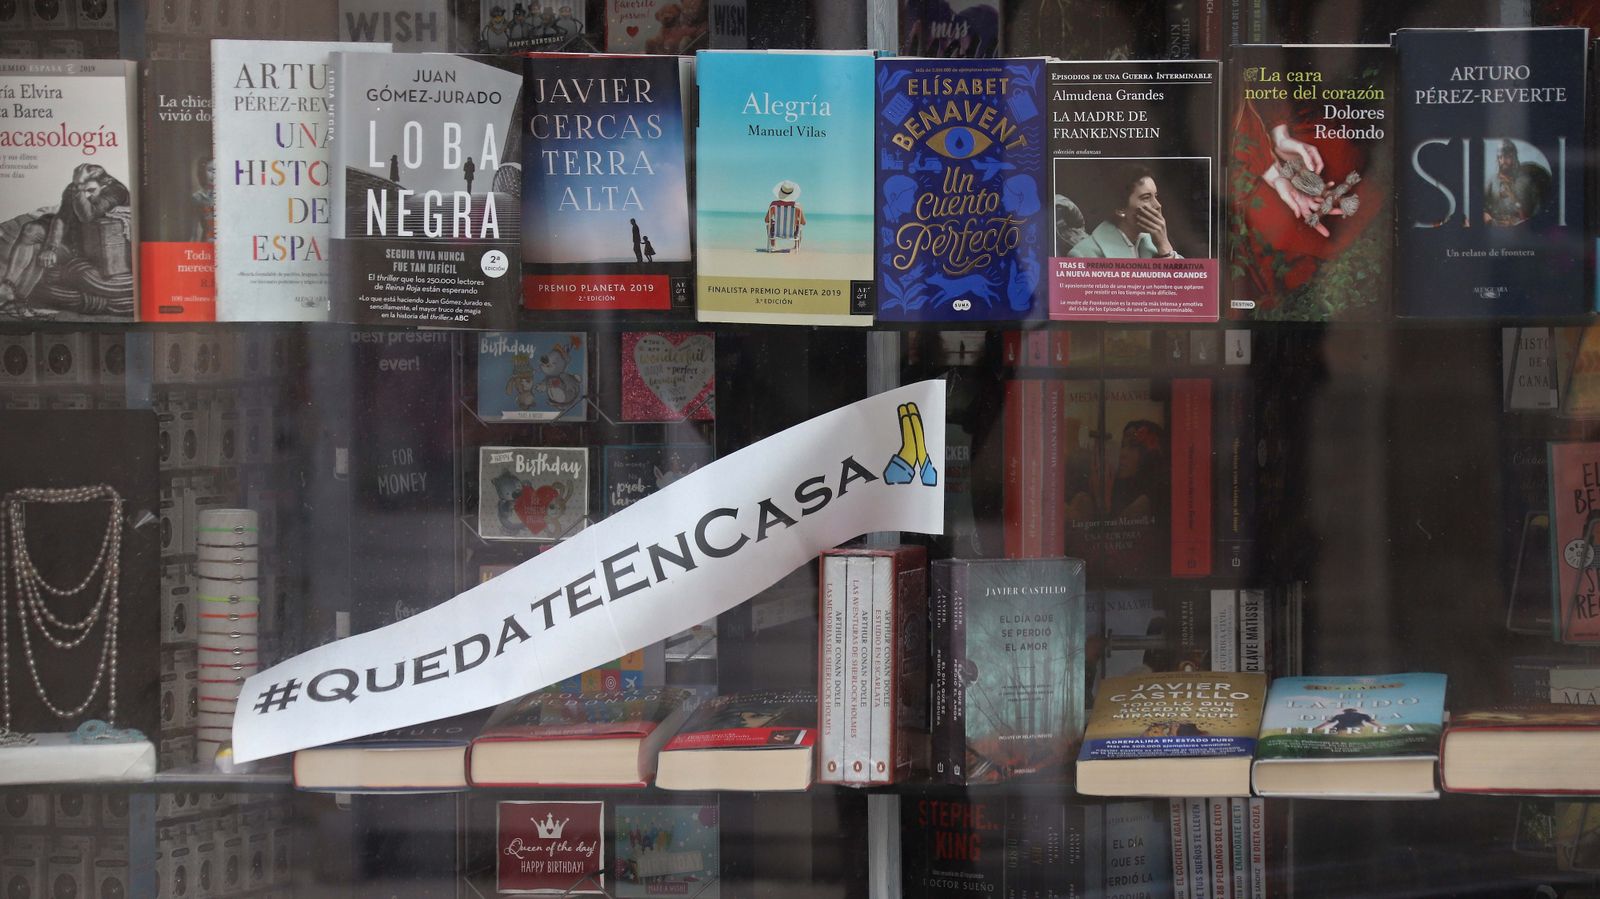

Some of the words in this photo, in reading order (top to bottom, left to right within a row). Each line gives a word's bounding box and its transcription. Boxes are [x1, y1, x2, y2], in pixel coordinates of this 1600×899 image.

[346, 12, 436, 42] WISH
[714, 5, 745, 36] WISH
[234, 63, 329, 89] ARTU
[413, 70, 456, 82] JUAN
[1260, 67, 1281, 82] La
[1287, 71, 1323, 82] cara
[1450, 65, 1531, 81] ARTURO
[20, 83, 63, 99] Elvira
[535, 78, 654, 103] JAVIER
[908, 75, 1009, 95] ELÍSABET
[1245, 88, 1287, 100] norte
[1294, 85, 1317, 100] del
[1322, 85, 1385, 100] corazón
[160, 95, 177, 107] La
[234, 92, 329, 112] PÉREZ-REV
[367, 85, 502, 104] GÓMEZ-JURADO
[1053, 90, 1112, 101] Almudena
[1116, 89, 1164, 100] Grandes
[1415, 87, 1567, 105] PÉREZ-REVERTE
[13, 104, 53, 118] Barea
[159, 109, 191, 121] vivió
[742, 92, 832, 122] Alegría
[1323, 105, 1385, 119] Dolores
[1053, 111, 1070, 122] LA
[1074, 111, 1124, 122] MADRE
[1128, 111, 1147, 121] DE
[530, 114, 662, 139] CERCAS
[749, 125, 793, 136] Manuel
[797, 126, 826, 137] Vilas
[892, 100, 1027, 151] BENAVENT
[1053, 128, 1160, 138] FRANKENSTEIN
[1314, 125, 1385, 139] Redondo
[0, 121, 118, 155] acasología
[370, 121, 499, 170] LOBA
[542, 150, 655, 176] TERRA
[235, 160, 329, 186] HISTO
[943, 166, 974, 194] Un
[1412, 137, 1568, 228] SIDI
[558, 186, 645, 211] ALTA
[916, 189, 999, 220] Cuento
[289, 198, 329, 224] DE
[367, 189, 500, 239] NEGRA
[253, 236, 326, 261] ESPA
[894, 215, 1027, 276] Perfecto
[1447, 249, 1460, 257] Un
[1462, 248, 1486, 257] relato
[1489, 249, 1499, 257] de
[1501, 248, 1535, 257] frontera
[386, 249, 415, 259] SEGUIR
[418, 250, 435, 260] VIVA
[438, 251, 465, 261] NUNCA
[393, 262, 407, 271] FUE
[411, 263, 425, 272] TAN
[428, 263, 457, 274] DIFÍCIL
[630, 284, 654, 292] 2019
[708, 286, 747, 294] FINALISTA
[751, 287, 781, 295] PREMIO
[388, 332, 447, 345] present
[481, 338, 536, 358] Birthday
[379, 356, 420, 371] ever!
[392, 448, 413, 465] FOR
[516, 453, 582, 479] Birthday
[378, 472, 427, 496] MONEY
[985, 587, 1019, 596] JAVIER
[1021, 586, 1066, 595] CASTILLO
[1000, 615, 1010, 623] EL
[1014, 613, 1031, 623] DÍA
[1034, 614, 1054, 622] QUE
[1245, 600, 1258, 643] MATISSE
[1002, 629, 1013, 637] SE
[1017, 627, 1051, 637] PERDIÓ
[826, 644, 832, 654] DE
[875, 647, 880, 659] EN
[1020, 642, 1048, 651] AMOR
[1246, 644, 1258, 671] CLAVE
[1131, 682, 1231, 692] JAVIER
[1110, 691, 1249, 702] CASTILLO
[1172, 804, 1181, 836] AGALLAS
[1213, 804, 1222, 826] ÉXITO
[1234, 815, 1241, 824] DE
[1252, 805, 1260, 829] COJEA
[1215, 828, 1223, 841] DEL
[504, 837, 542, 860] Queen
[545, 842, 558, 857] of
[557, 840, 573, 852] the
[575, 840, 596, 858] day!
[935, 832, 982, 862] KING
[1233, 826, 1243, 871] ENAMÓRATE
[1174, 839, 1183, 875] COCIENTE
[1214, 843, 1223, 883] PELDAÑOS
[1254, 854, 1261, 863] MI
[521, 861, 545, 873] HAPPY
[547, 860, 584, 874] BIRTHDAY!
[963, 877, 994, 892] SUEÑO
[1176, 878, 1184, 886] EL
[1217, 885, 1224, 895] 88
